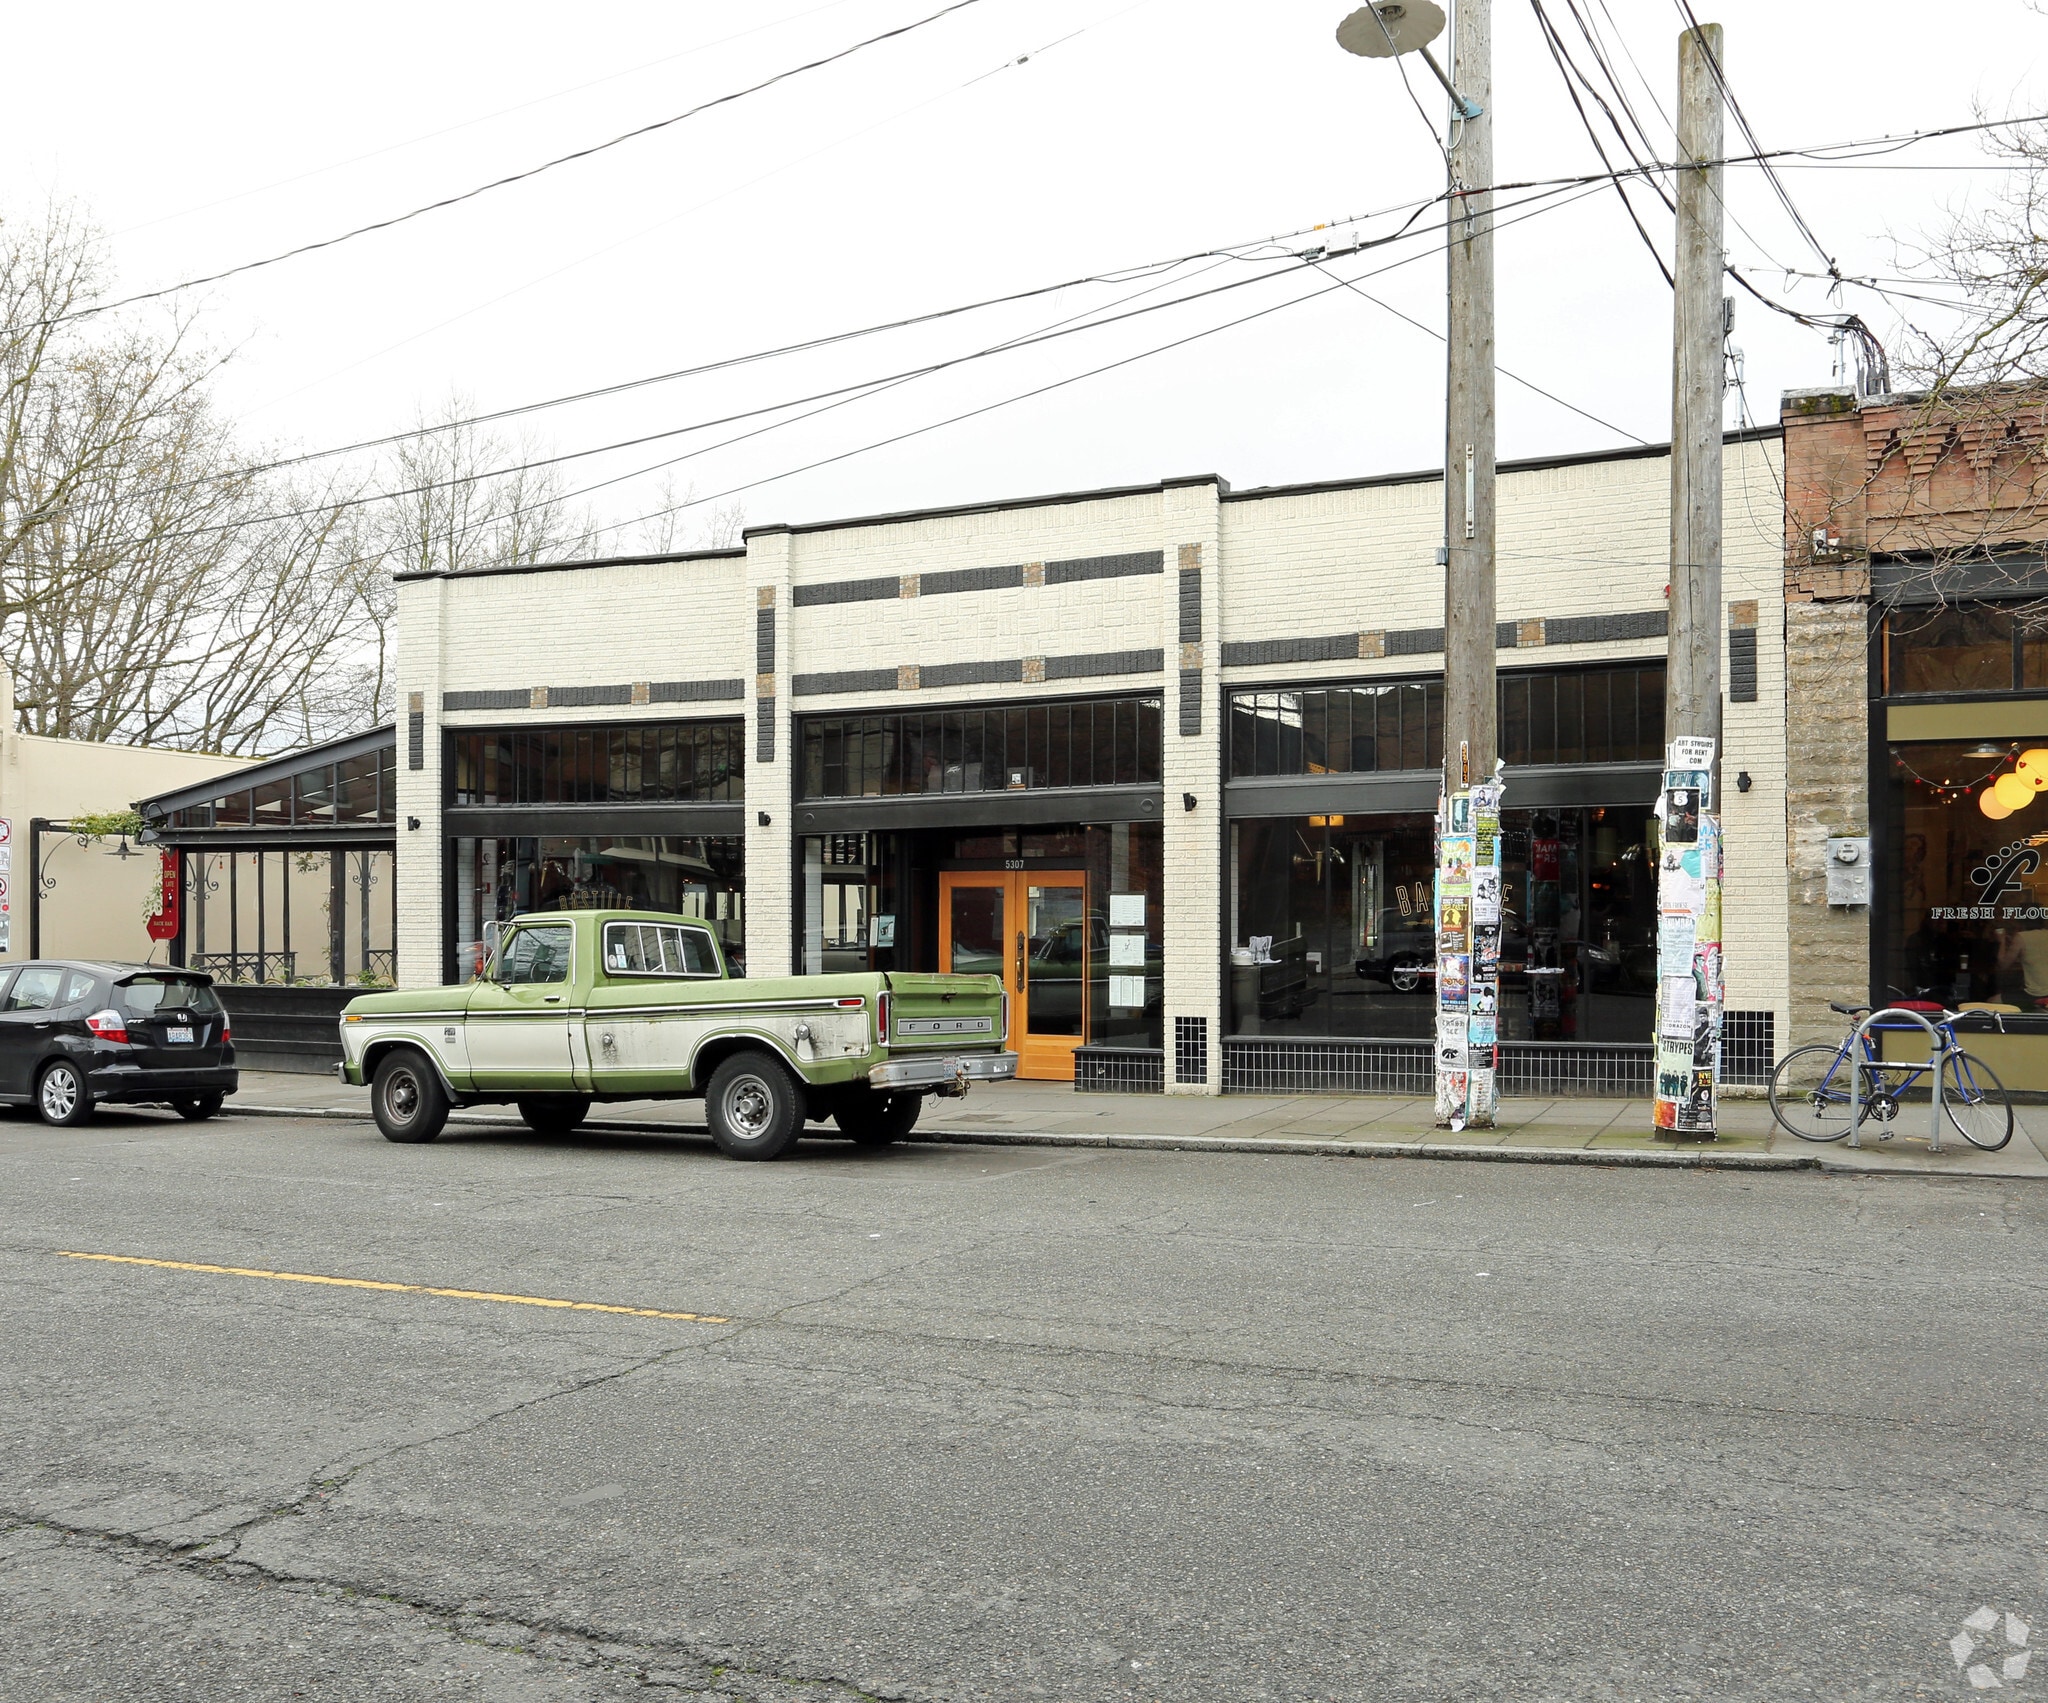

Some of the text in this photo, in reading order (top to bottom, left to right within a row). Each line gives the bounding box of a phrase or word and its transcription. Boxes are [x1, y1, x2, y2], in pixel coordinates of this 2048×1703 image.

[1005, 860, 1025, 869] 5307
[164, 870, 176, 878] OPEN
[1931, 907, 1996, 919] FRESH
[908, 1021, 984, 1031] FORD
[1662, 1040, 1693, 1055] STRYPES
